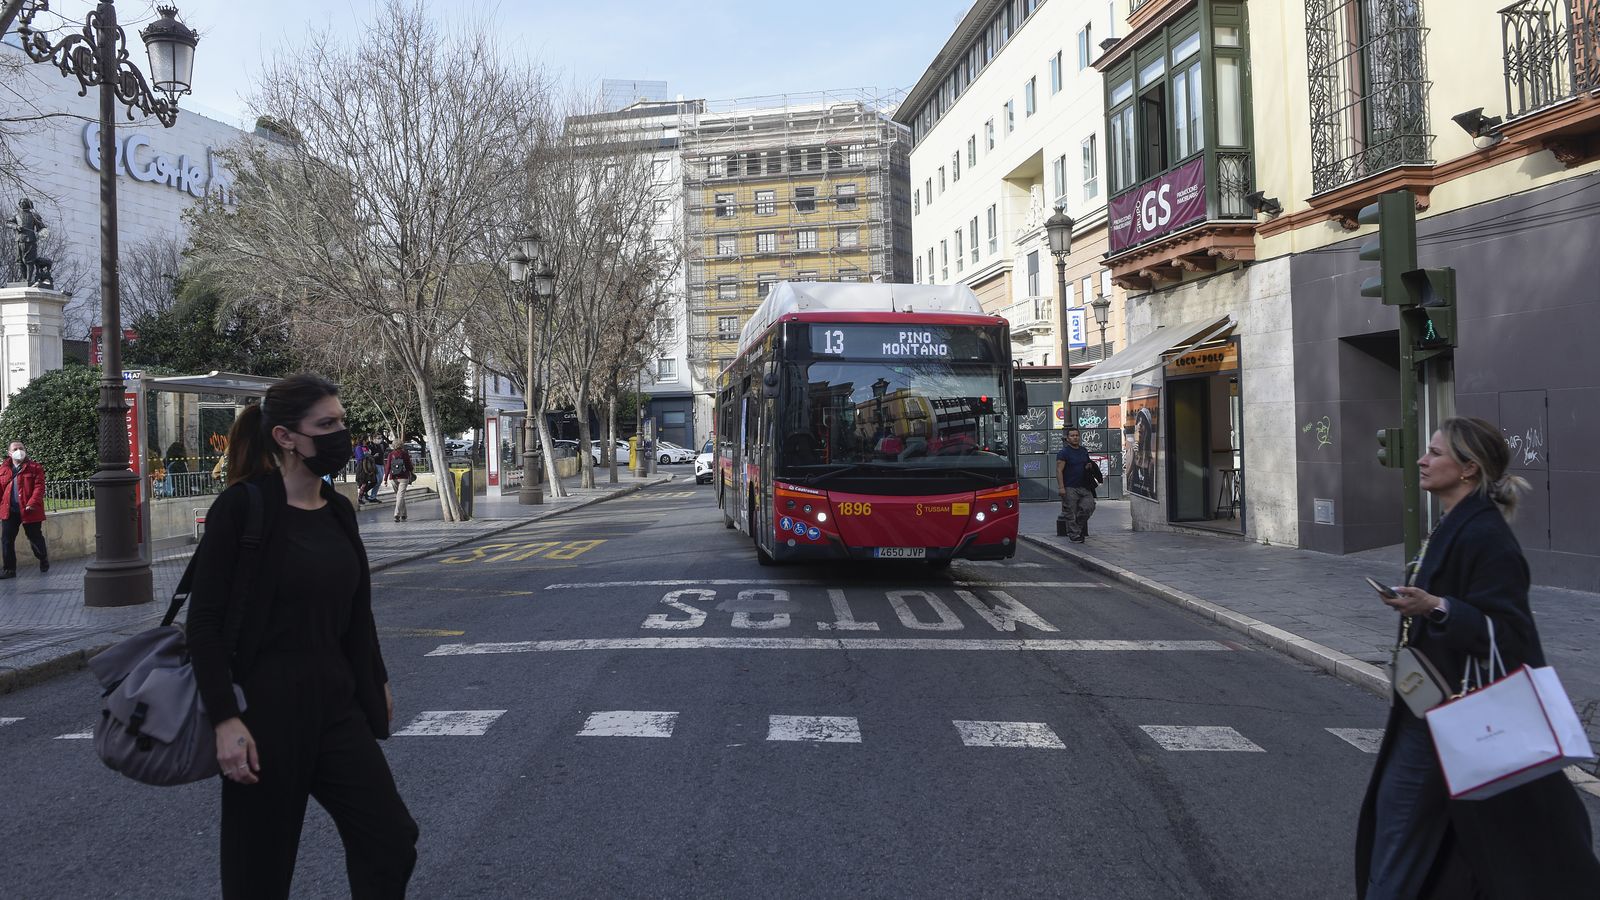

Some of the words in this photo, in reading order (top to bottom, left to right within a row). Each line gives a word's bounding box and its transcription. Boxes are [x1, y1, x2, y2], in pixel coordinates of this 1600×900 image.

[125, 133, 205, 198] Corte
[1142, 184, 1171, 231] GS
[1072, 315, 1080, 341] ALDI
[824, 330, 844, 354] 13
[899, 332, 932, 343] PINO
[882, 343, 947, 355] MONTANO
[1176, 357, 1196, 366] LOCO
[1202, 353, 1224, 363] POLO
[1081, 383, 1098, 393] LOCO
[1103, 381, 1121, 390] POLO
[838, 502, 872, 516] 1896
[880, 548, 904, 557] 4650
[906, 548, 924, 557] JVP
